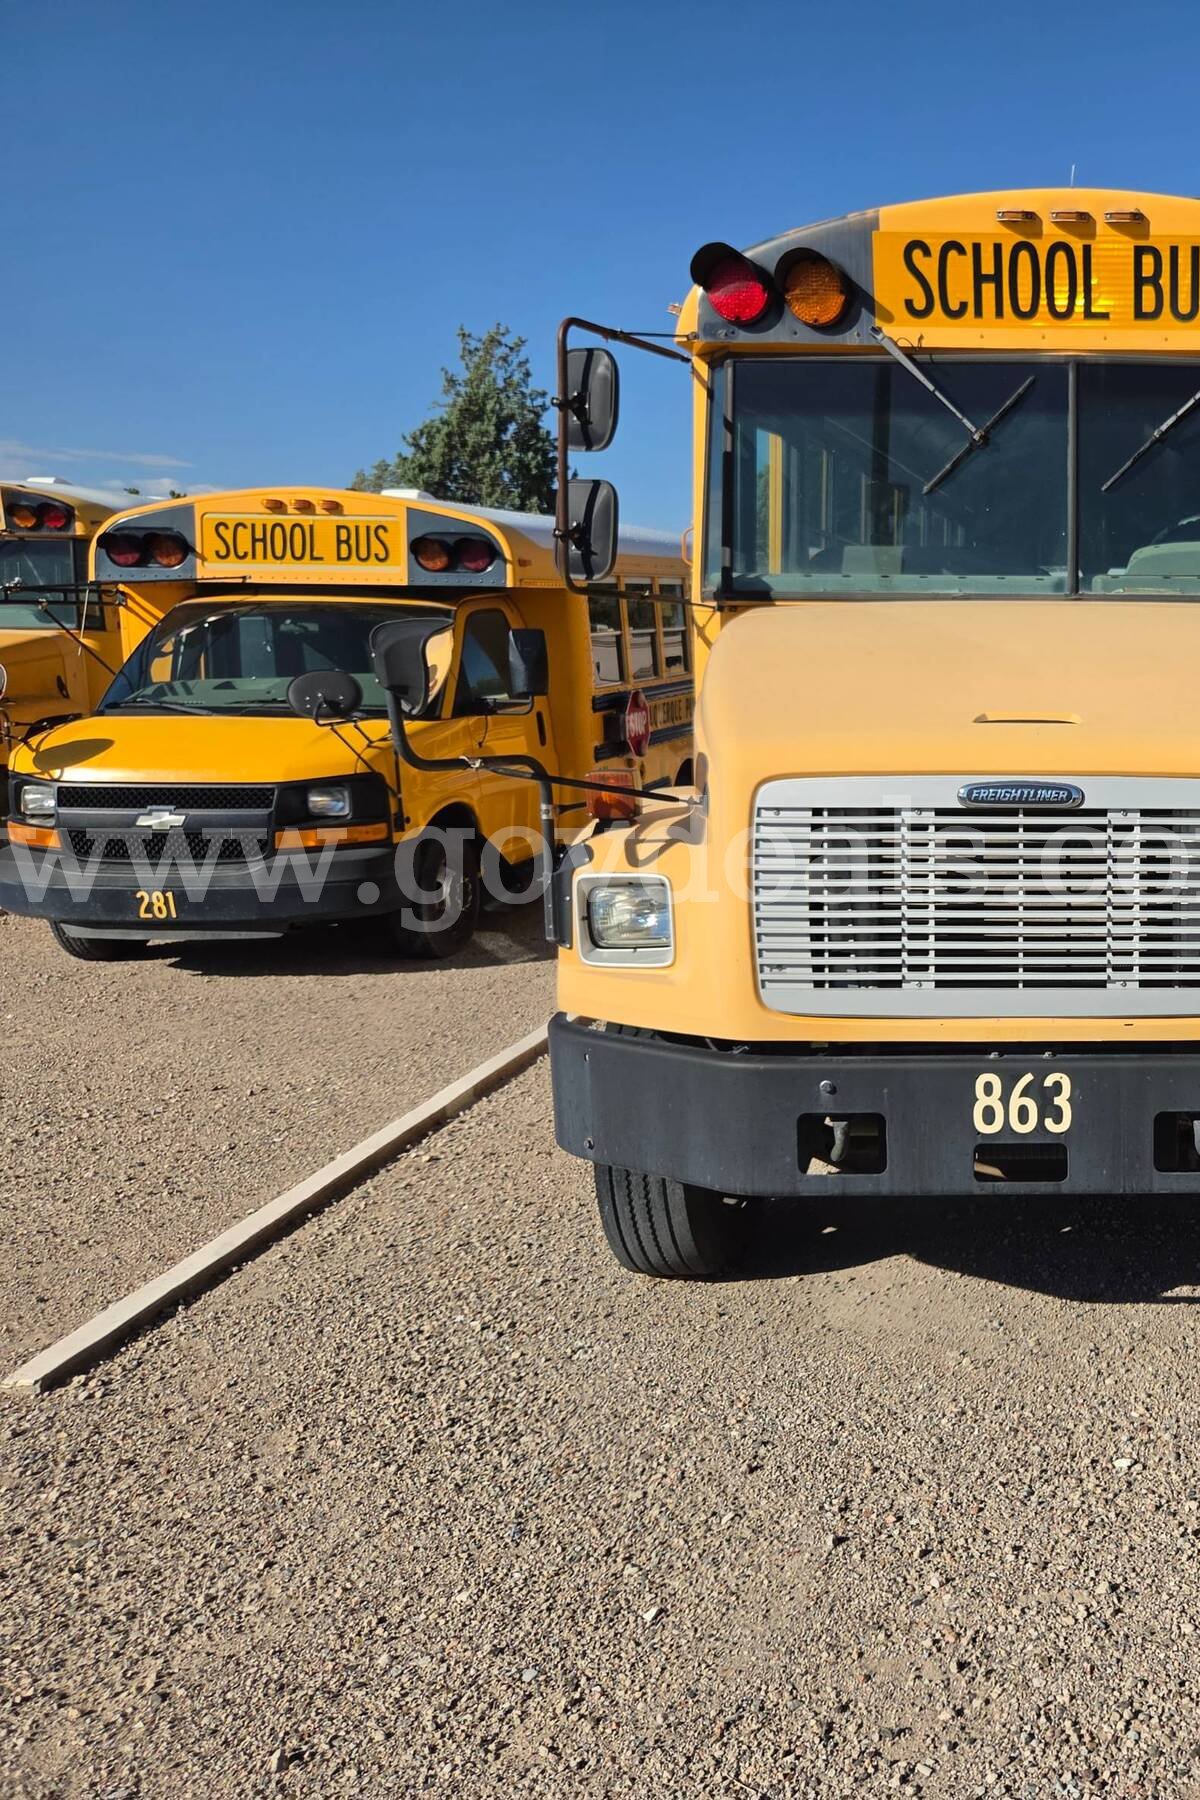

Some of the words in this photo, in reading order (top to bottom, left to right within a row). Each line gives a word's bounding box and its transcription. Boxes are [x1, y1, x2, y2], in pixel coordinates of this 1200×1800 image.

[903, 240, 1110, 320] SCHOOL
[214, 521, 324, 561] SCHOOL
[336, 524, 390, 563] BUS
[630, 711, 647, 736] STOP
[970, 788, 1068, 801] FREIGHTLINER
[135, 890, 177, 919] 281
[973, 1072, 1072, 1134] 863
